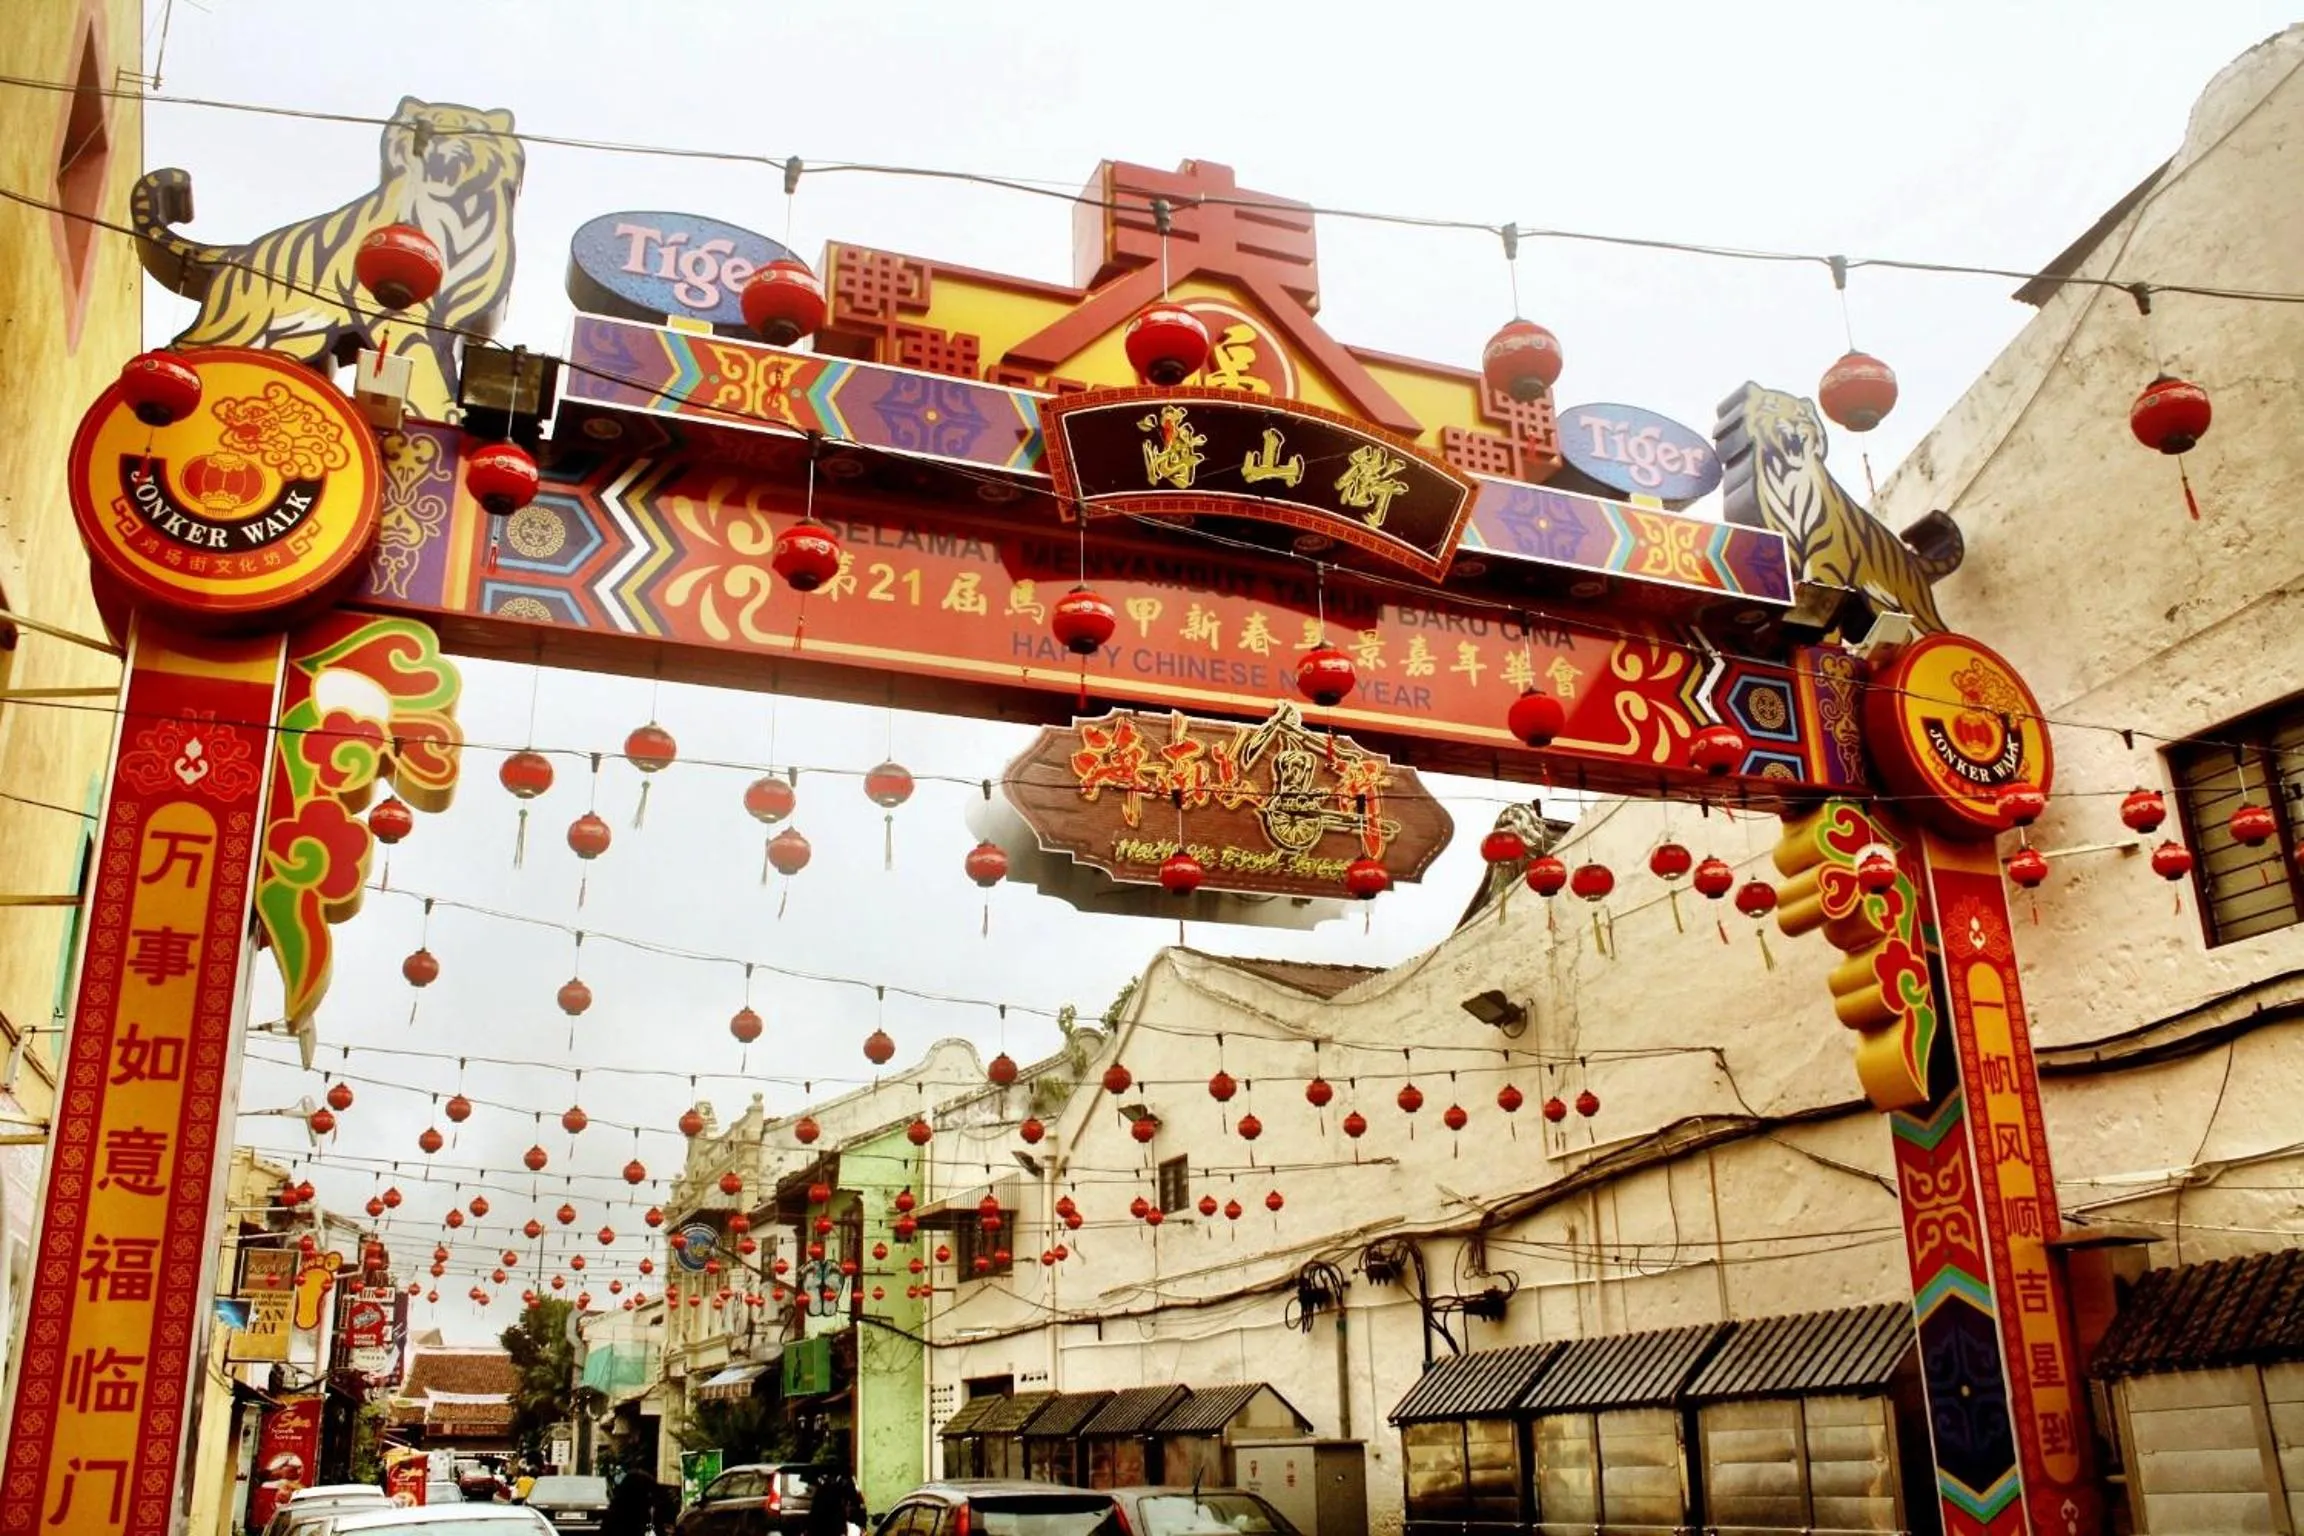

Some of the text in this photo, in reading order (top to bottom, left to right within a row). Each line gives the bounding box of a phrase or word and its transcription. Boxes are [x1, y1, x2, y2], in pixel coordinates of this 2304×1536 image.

[614, 222, 760, 310] Tige
[1580, 415, 1704, 488] Tiger
[131, 470, 313, 548] JONKER WALK
[1397, 604, 1488, 638] BARU
[1499, 616, 1576, 651] CNA
[1012, 631, 1122, 669] HAY
[1133, 648, 1269, 688] CHINESE
[1356, 680, 1431, 711] YEAR
[1930, 728, 2020, 783] JONKER WALK
[48, 829, 213, 1526] 万事如意福临门
[1971, 1000, 2072, 1457] 一帆风顺吉星到
